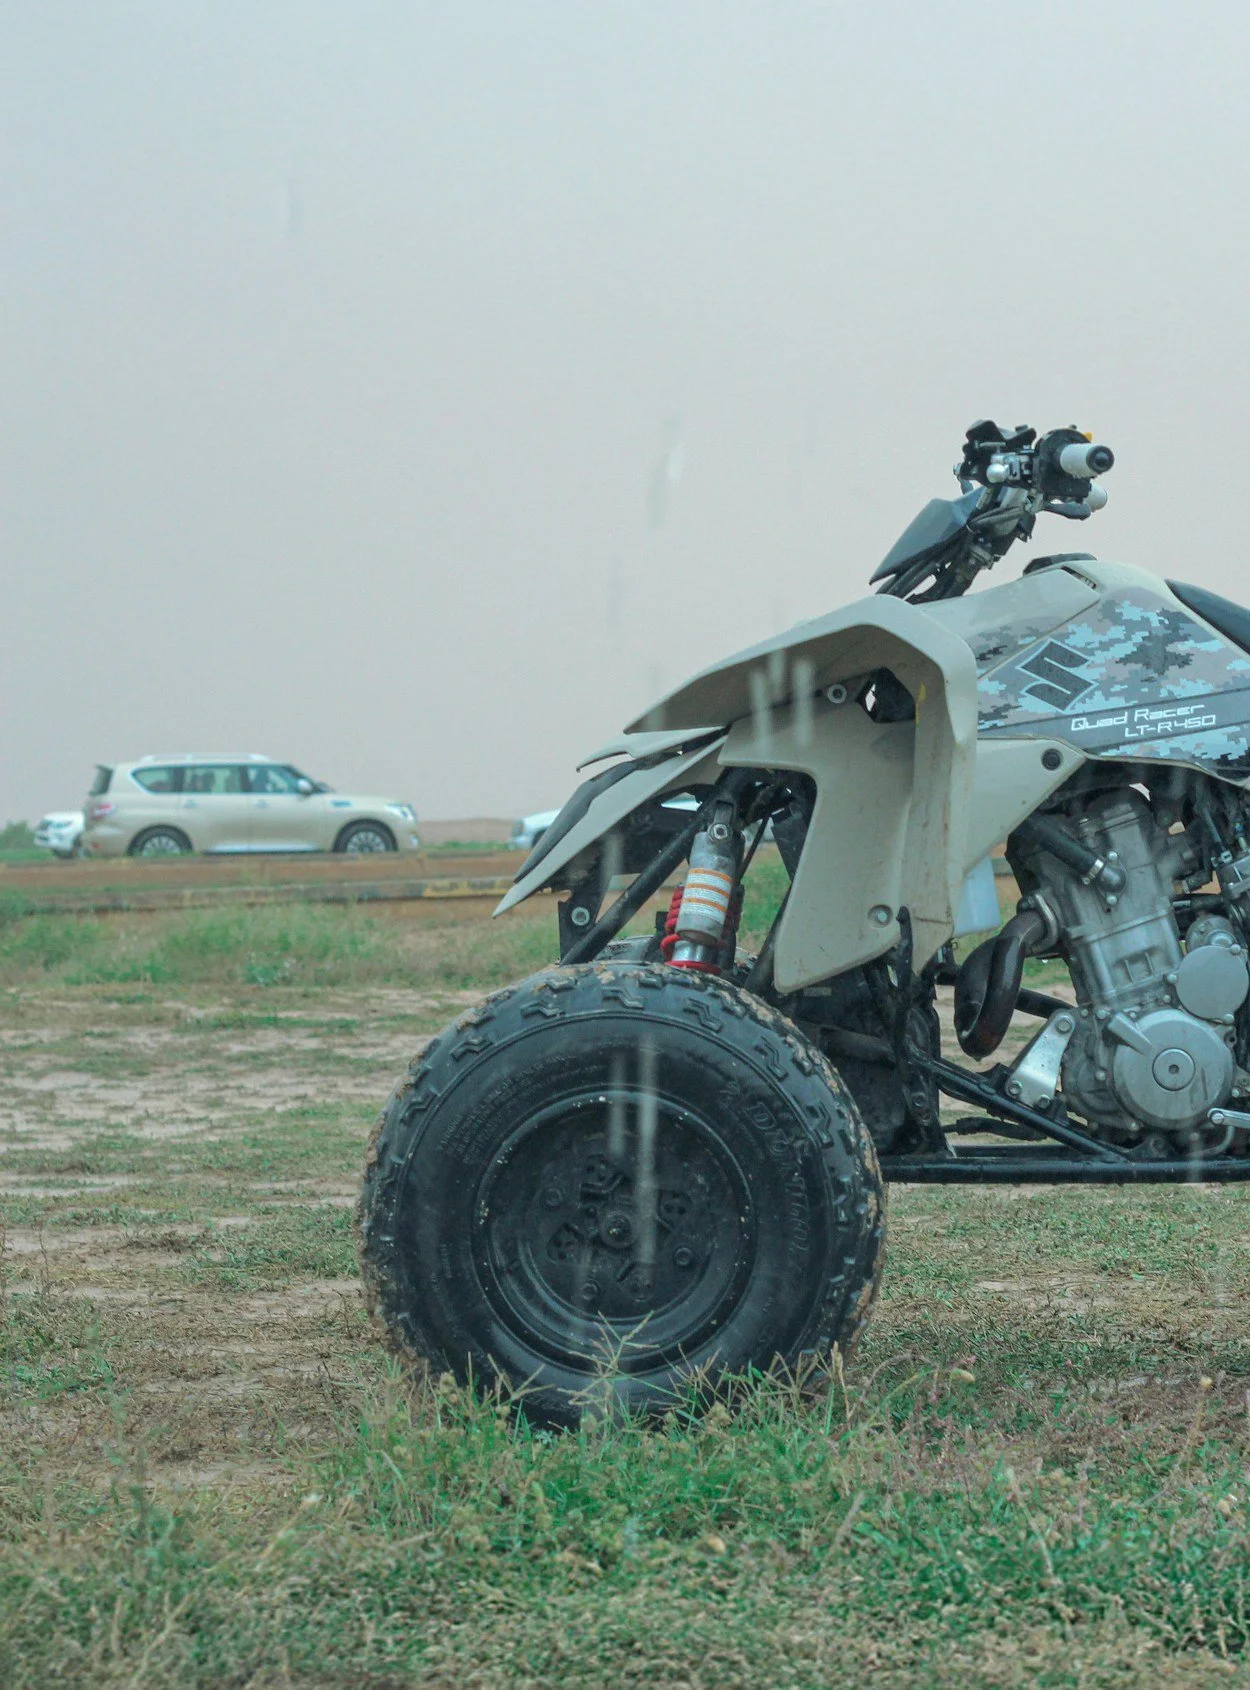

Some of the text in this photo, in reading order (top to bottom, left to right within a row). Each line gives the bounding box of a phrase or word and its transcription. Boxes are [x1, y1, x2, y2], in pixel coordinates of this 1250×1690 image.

[1070, 703, 1206, 732] Quad Racer
[1124, 714, 1217, 738] LT-R450
